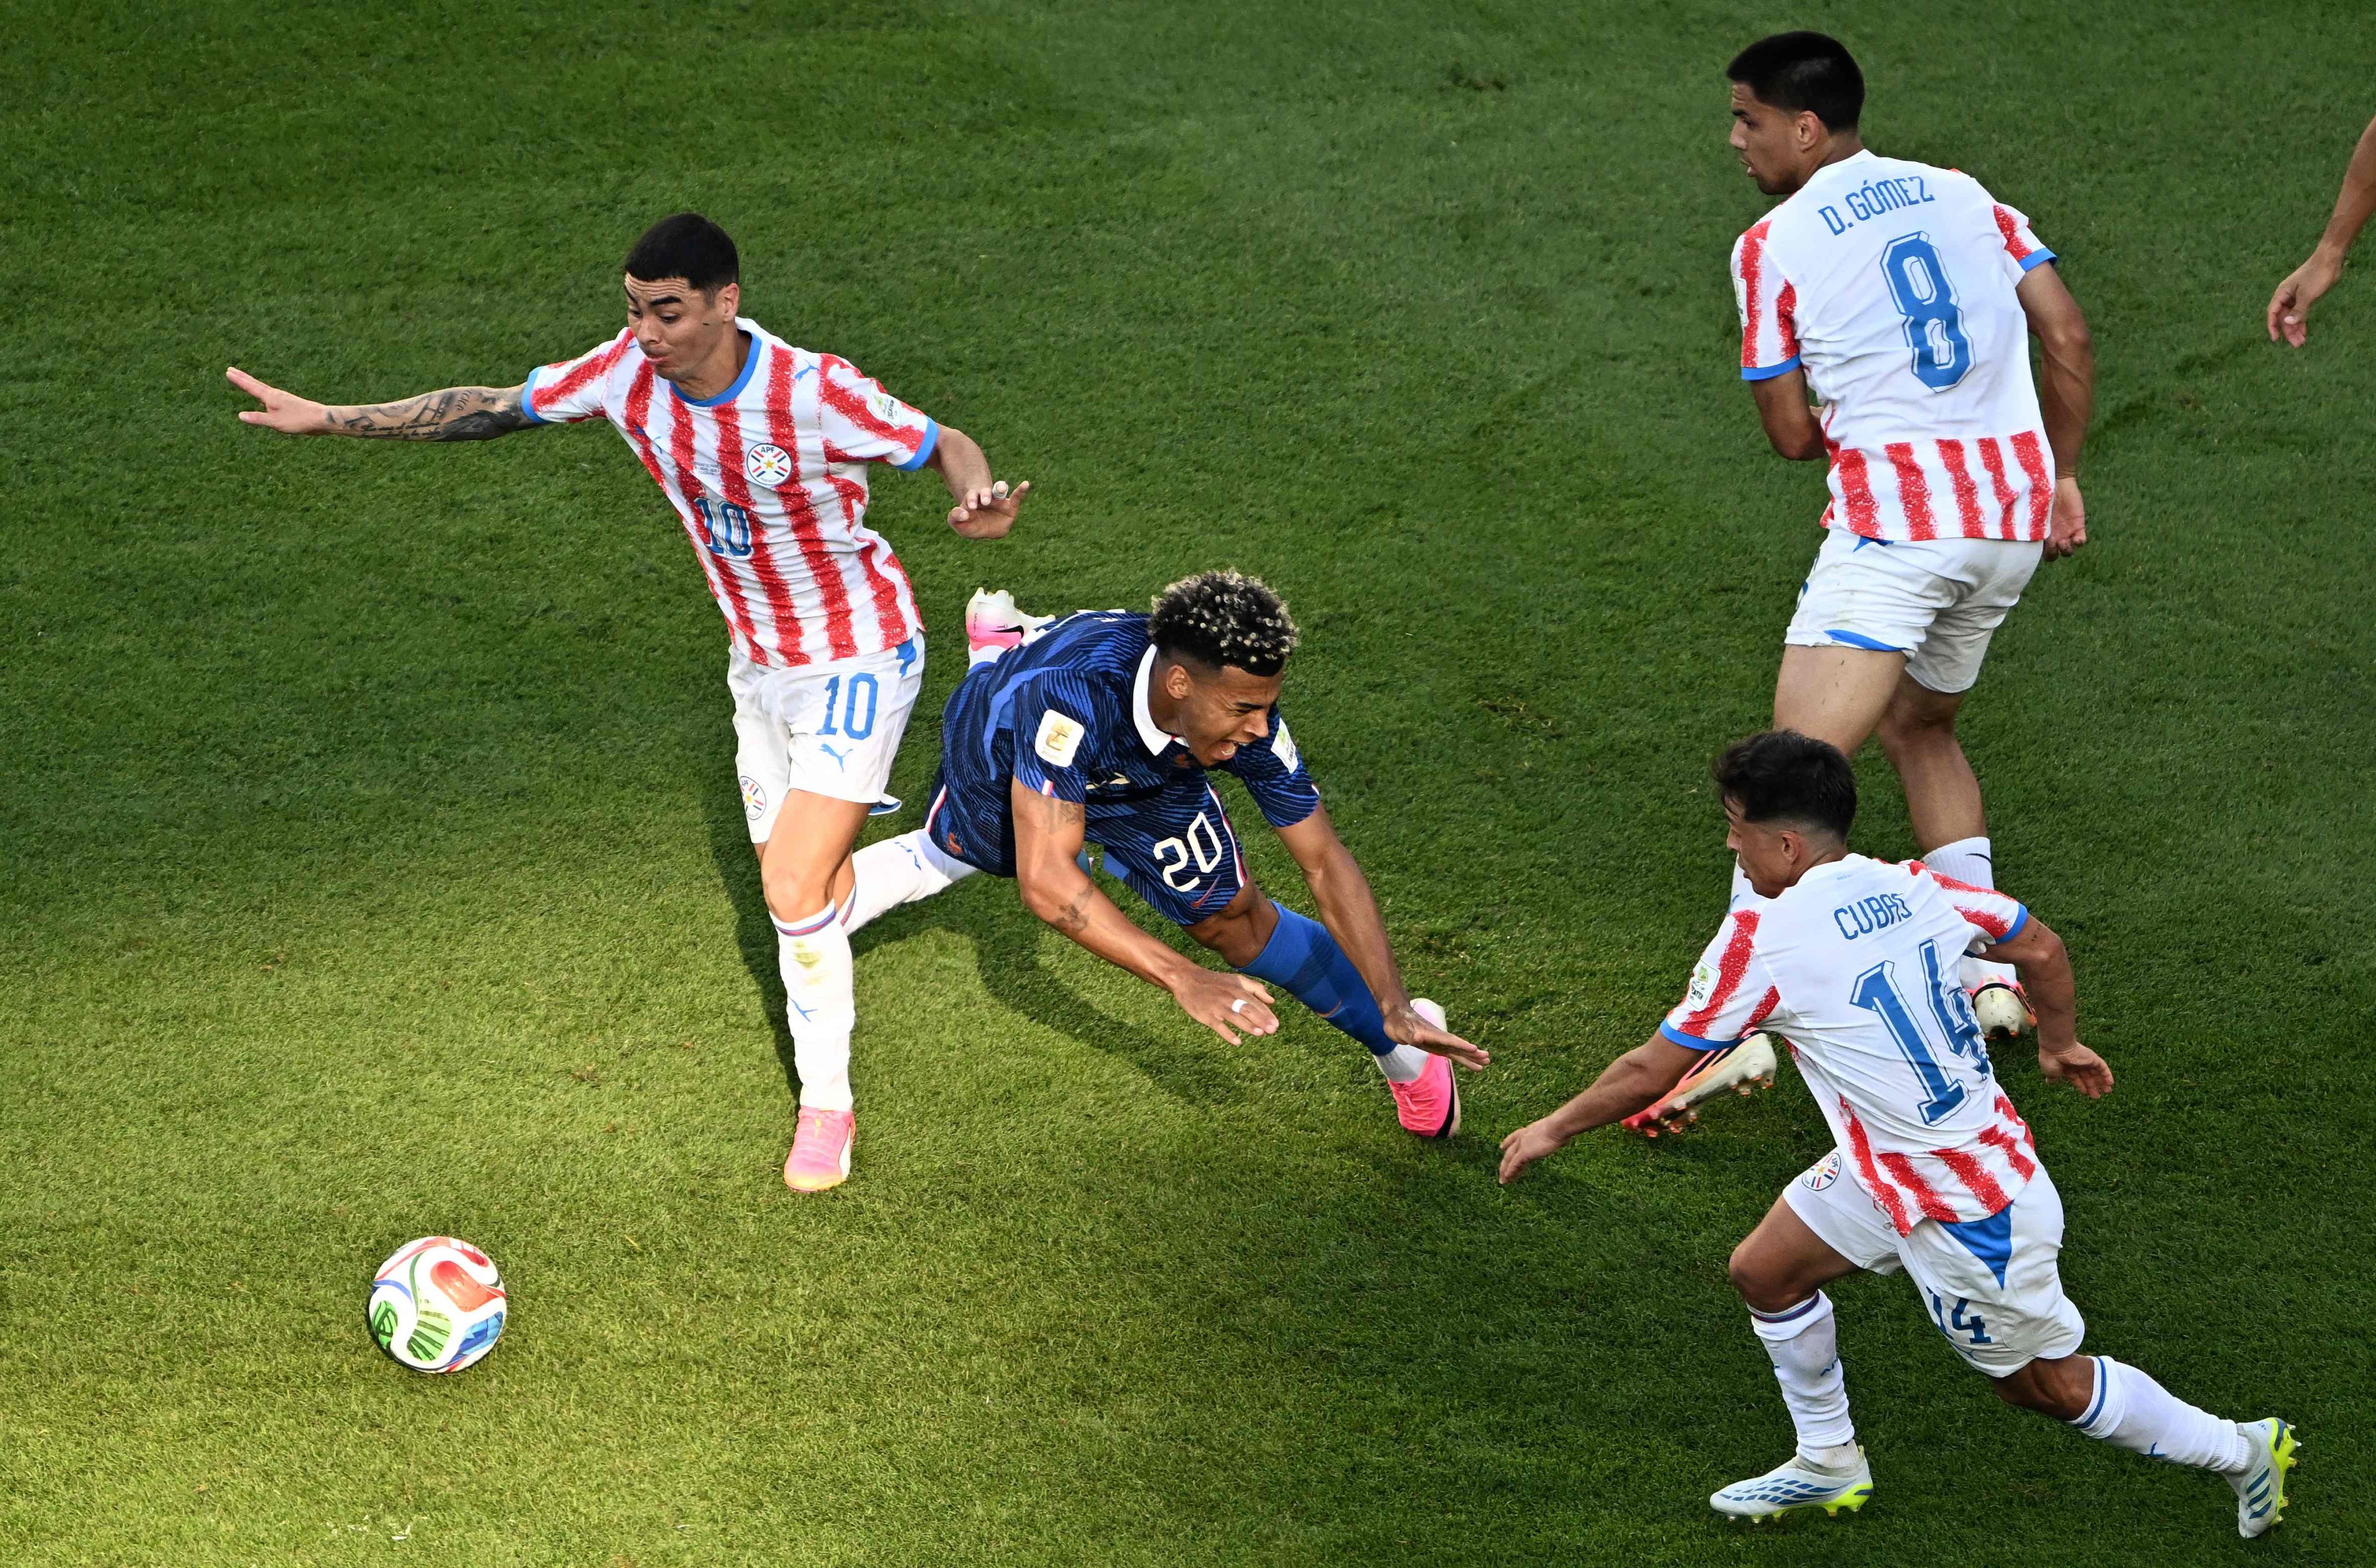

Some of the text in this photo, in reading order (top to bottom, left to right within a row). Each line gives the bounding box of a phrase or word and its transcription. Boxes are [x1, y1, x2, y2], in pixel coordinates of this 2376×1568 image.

[1818, 176, 1935, 236] D. GÓMEZ
[1880, 231, 1976, 394] 8
[694, 498, 754, 560] 10
[815, 672, 878, 740] 10
[1153, 812, 1223, 892] 20
[1834, 893, 1912, 940] CUBAS
[1849, 939, 1993, 1127] 14
[1926, 1286, 1992, 1344] 14
